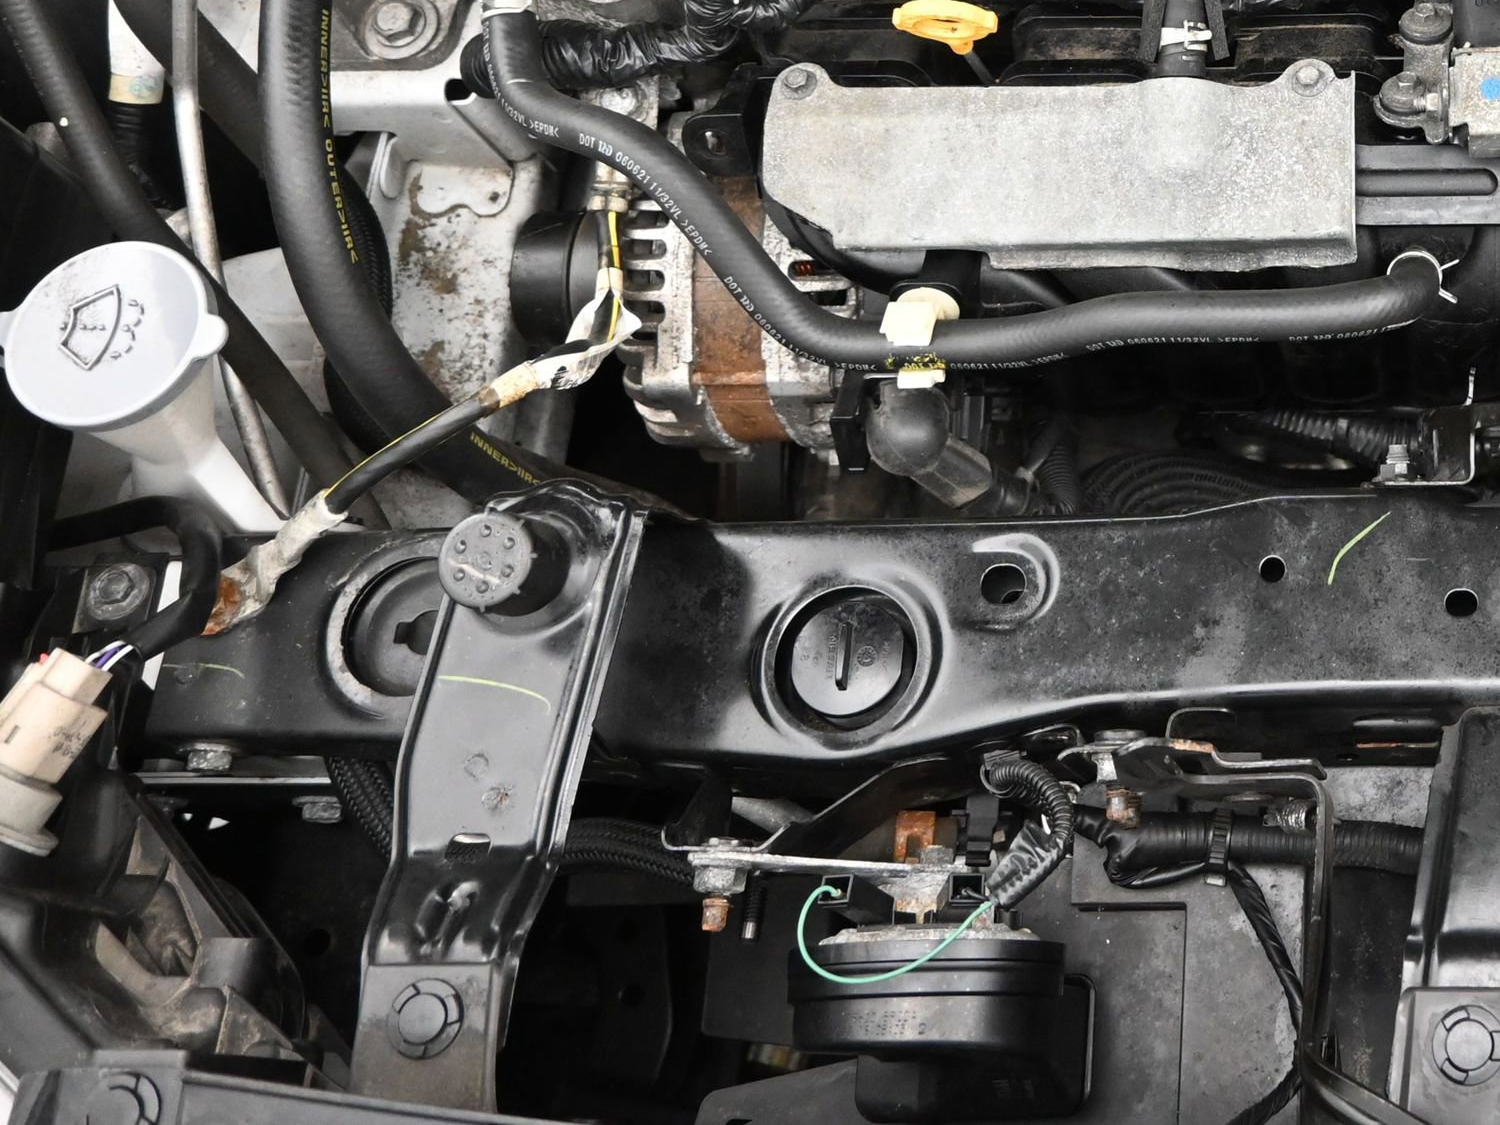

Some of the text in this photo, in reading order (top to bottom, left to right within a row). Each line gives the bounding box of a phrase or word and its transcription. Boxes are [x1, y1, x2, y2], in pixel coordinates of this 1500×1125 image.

[579, 133, 596, 149] DOT
[615, 151, 651, 184] 060621
[723, 276, 742, 295] DOT
